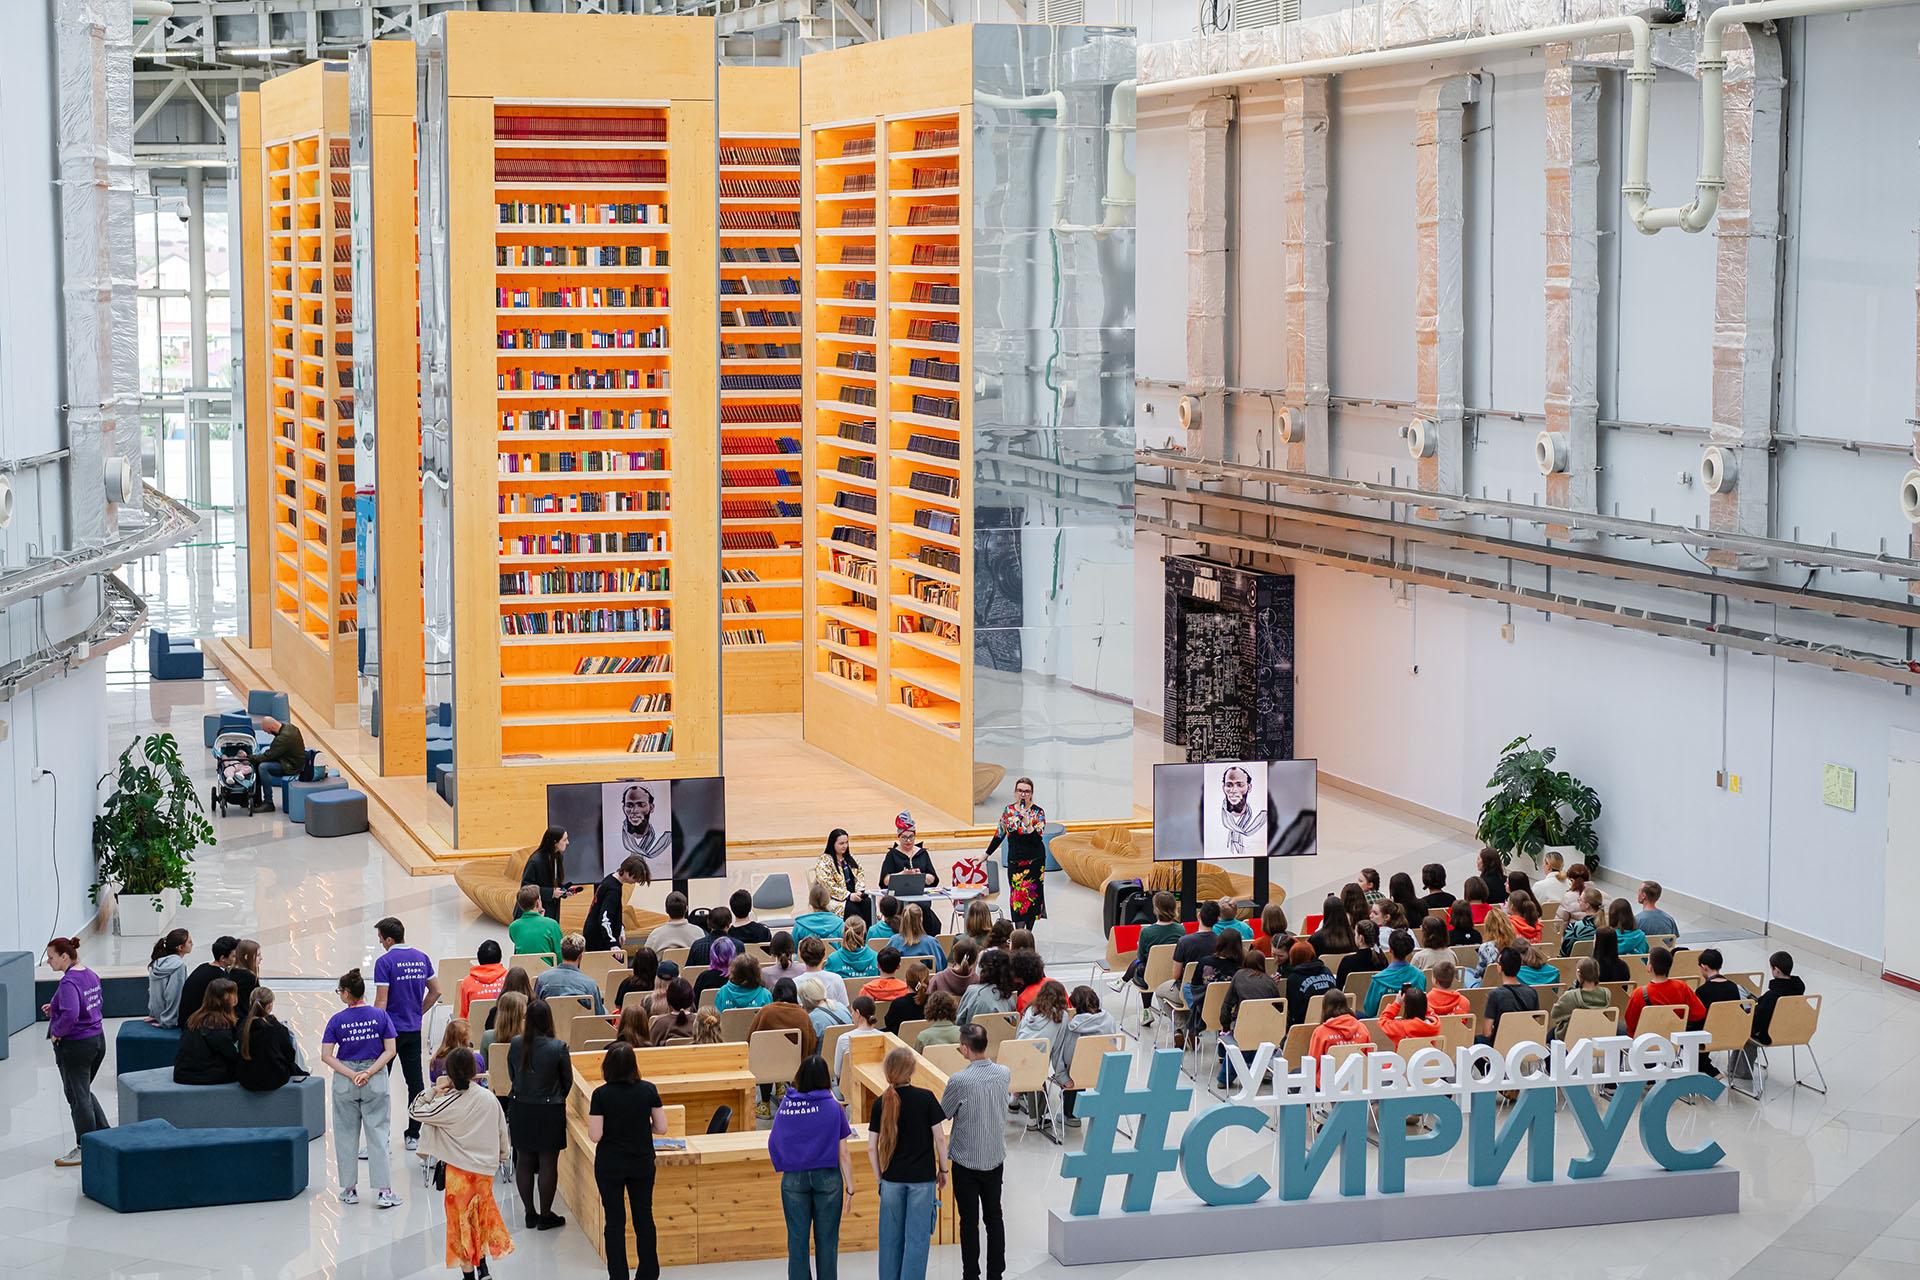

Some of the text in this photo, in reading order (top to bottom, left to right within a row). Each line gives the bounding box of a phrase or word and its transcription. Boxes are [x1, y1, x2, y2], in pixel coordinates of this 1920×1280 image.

[341, 1019, 378, 1029] Исследуй,
[1224, 1031, 1712, 1112] Университет
[1060, 1048, 1727, 1216] #СИРИУС
